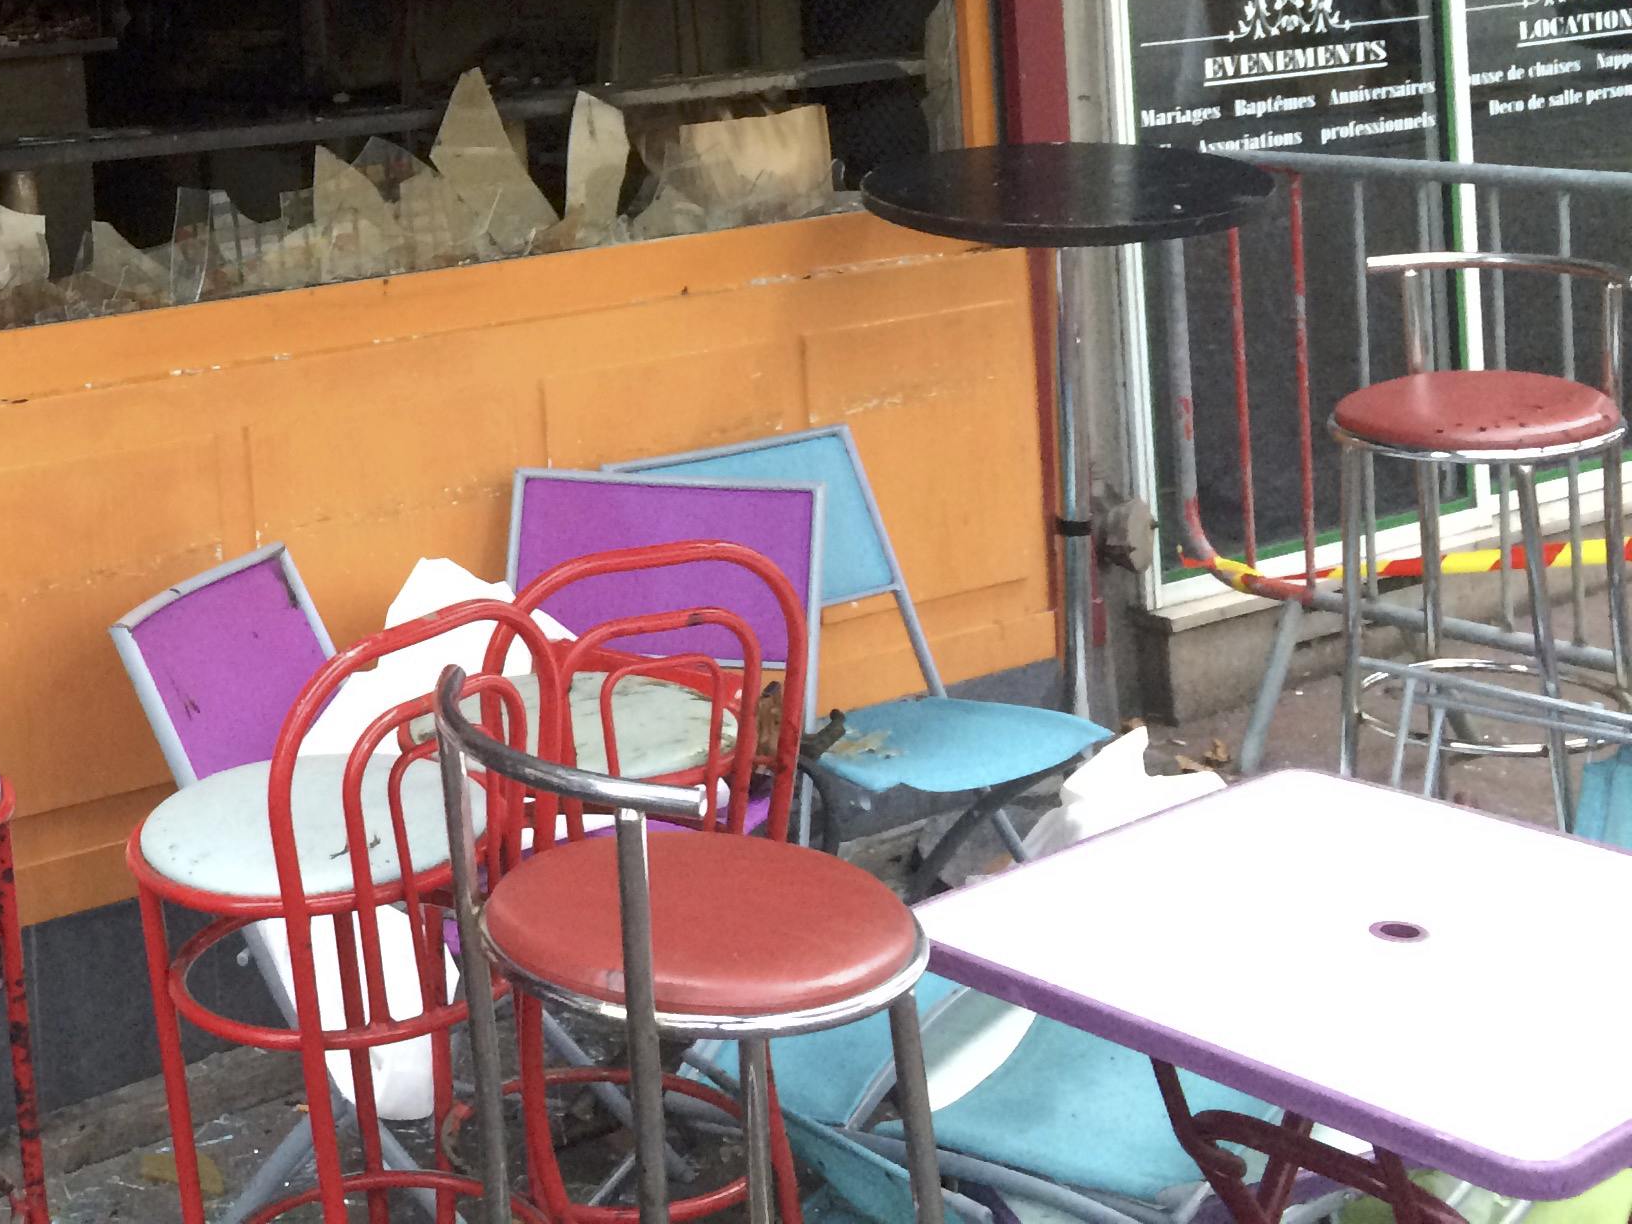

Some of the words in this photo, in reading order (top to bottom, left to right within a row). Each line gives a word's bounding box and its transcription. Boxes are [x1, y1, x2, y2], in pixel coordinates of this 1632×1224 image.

[1519, 8, 1632, 41] LOCATION
[1204, 40, 1386, 79] EVENEMENTS
[1470, 70, 1504, 86] usse
[1507, 64, 1525, 81] de
[1141, 106, 1221, 127] Mariages
[1328, 79, 1436, 105] Anniversaires
[1528, 94, 1545, 110] de
[1321, 112, 1436, 144] professionnels
